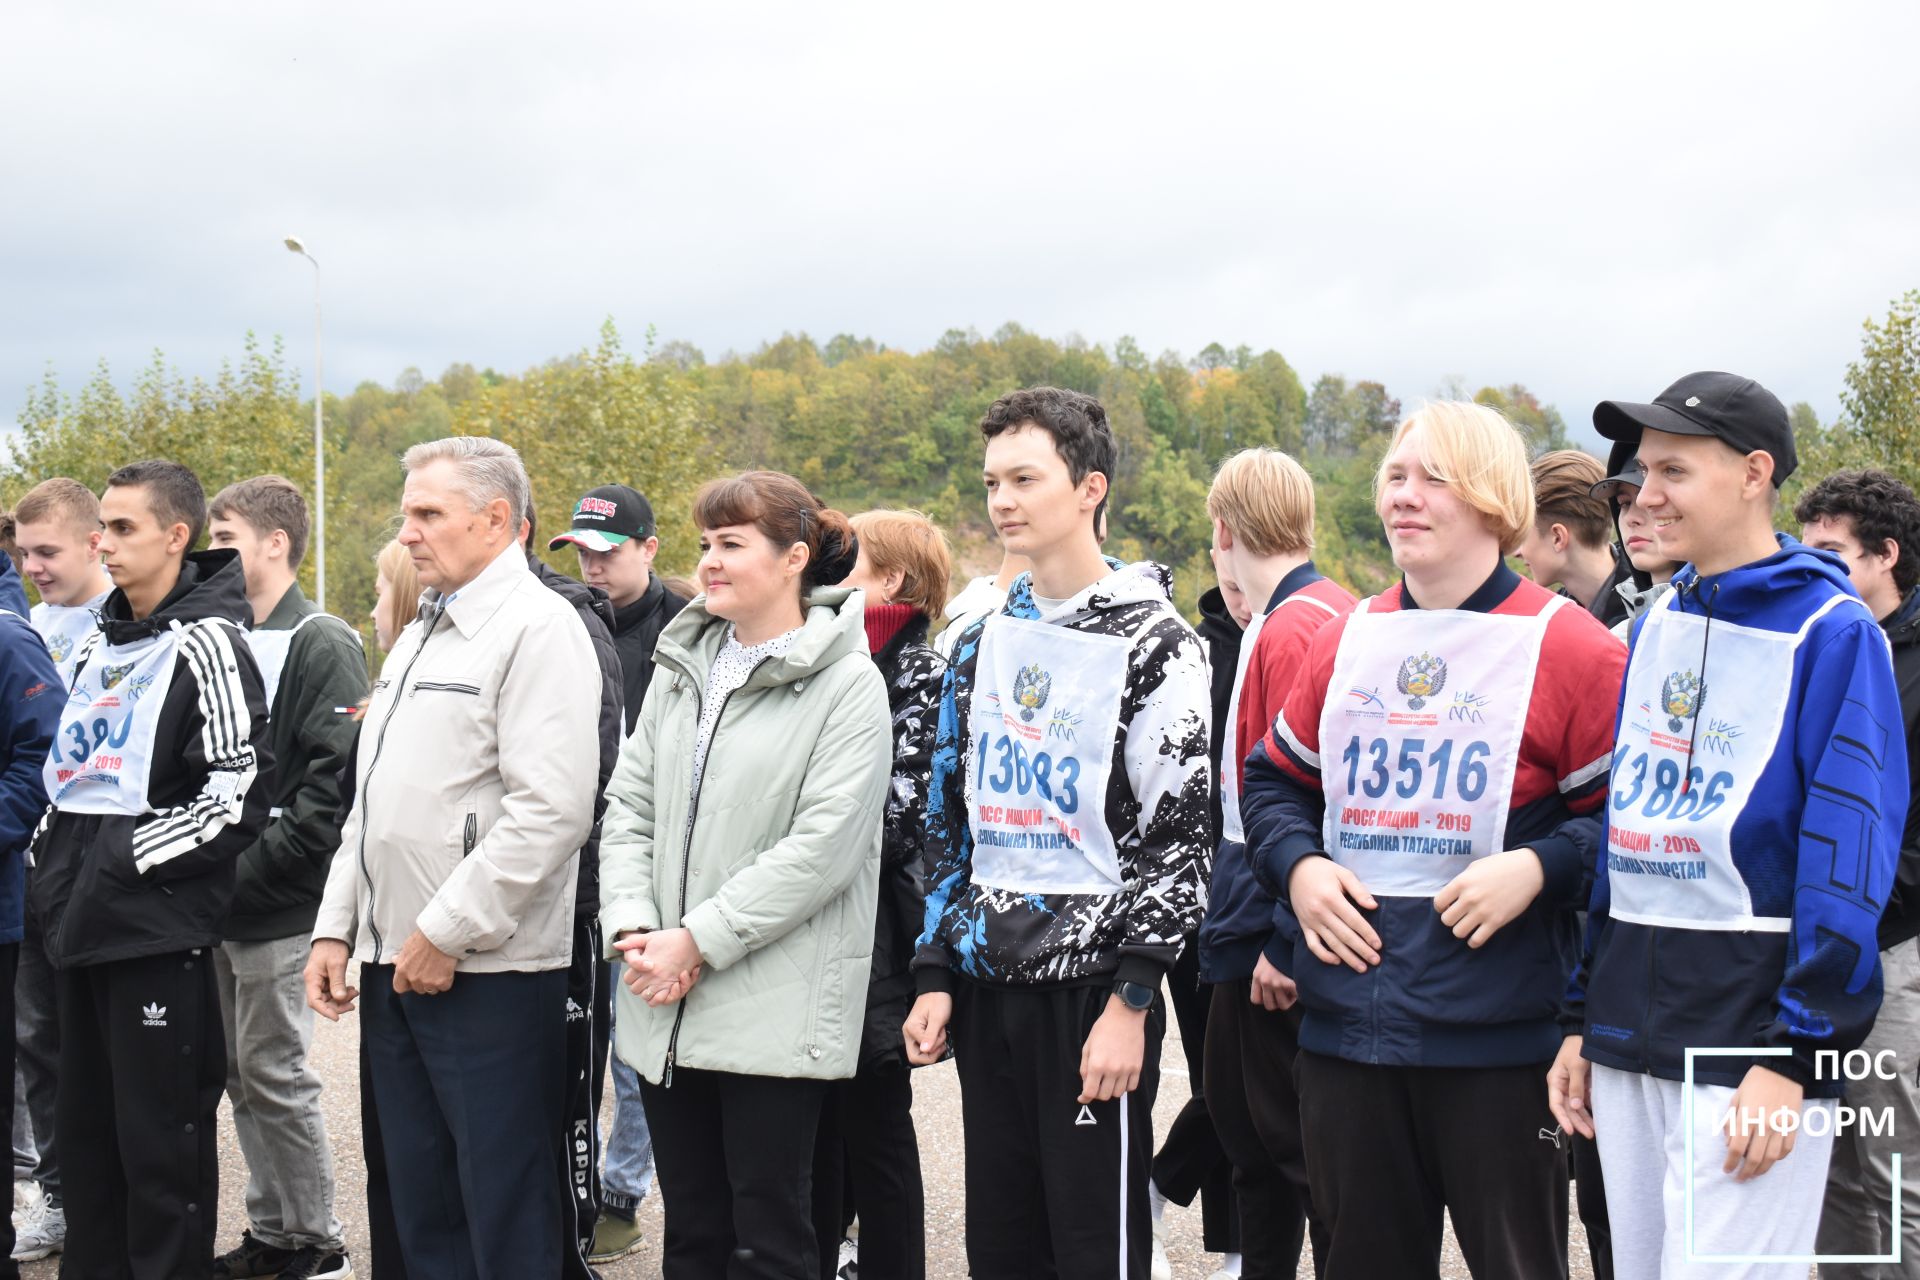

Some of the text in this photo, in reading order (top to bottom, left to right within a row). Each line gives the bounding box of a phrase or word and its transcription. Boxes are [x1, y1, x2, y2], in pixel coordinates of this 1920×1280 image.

[581, 498, 617, 517] BARS
[95, 756, 122, 770] 2019
[1342, 735, 1491, 802] 13516
[1608, 744, 1734, 822] 13866
[1377, 810, 1419, 830] НАЦИИ
[1436, 812, 1472, 832] 2019
[1340, 831, 1472, 855] РЕСПУБЛИКА ТАТАРСТАН
[1620, 830, 1651, 853] НАЦИИ
[1663, 834, 1701, 853] 2019
[1640, 859, 1707, 880] ТАТАРСТАН
[143, 1018, 167, 1026] adidas
[574, 1119, 588, 1199] Kappa
